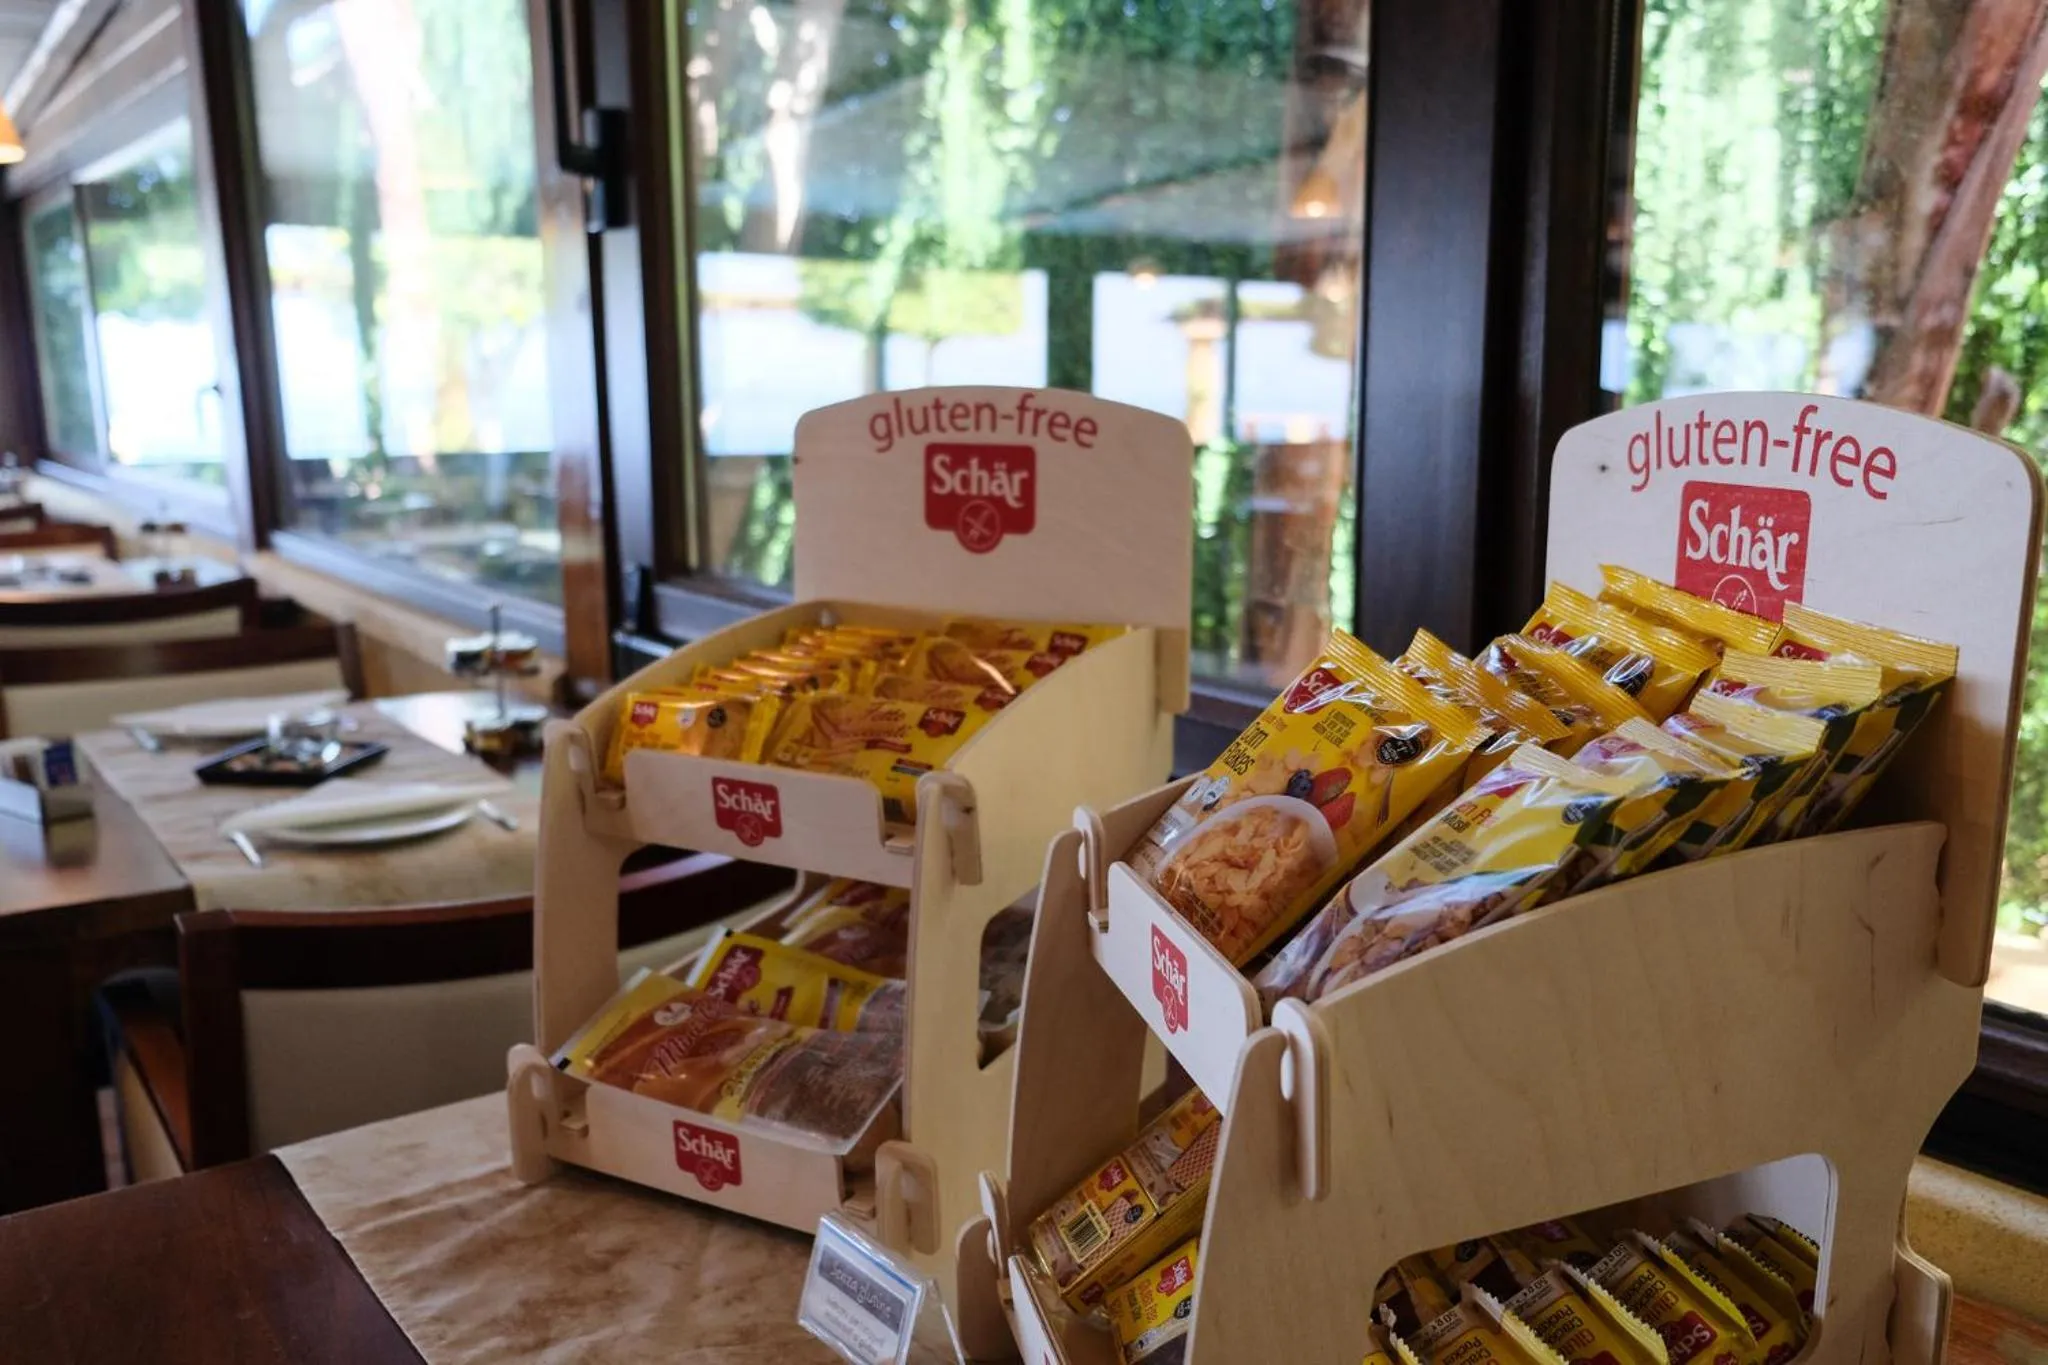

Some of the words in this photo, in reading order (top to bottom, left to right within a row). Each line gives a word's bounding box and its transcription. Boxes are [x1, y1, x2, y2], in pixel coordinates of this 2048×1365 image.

[868, 392, 1098, 453] gluten-free
[1627, 404, 1897, 500] gluten-free
[931, 454, 1028, 507] Schär
[1685, 499, 1799, 591] Schär
[716, 781, 775, 822] Schär
[1153, 935, 1186, 1006] Schär
[677, 1127, 736, 1168] Schär
